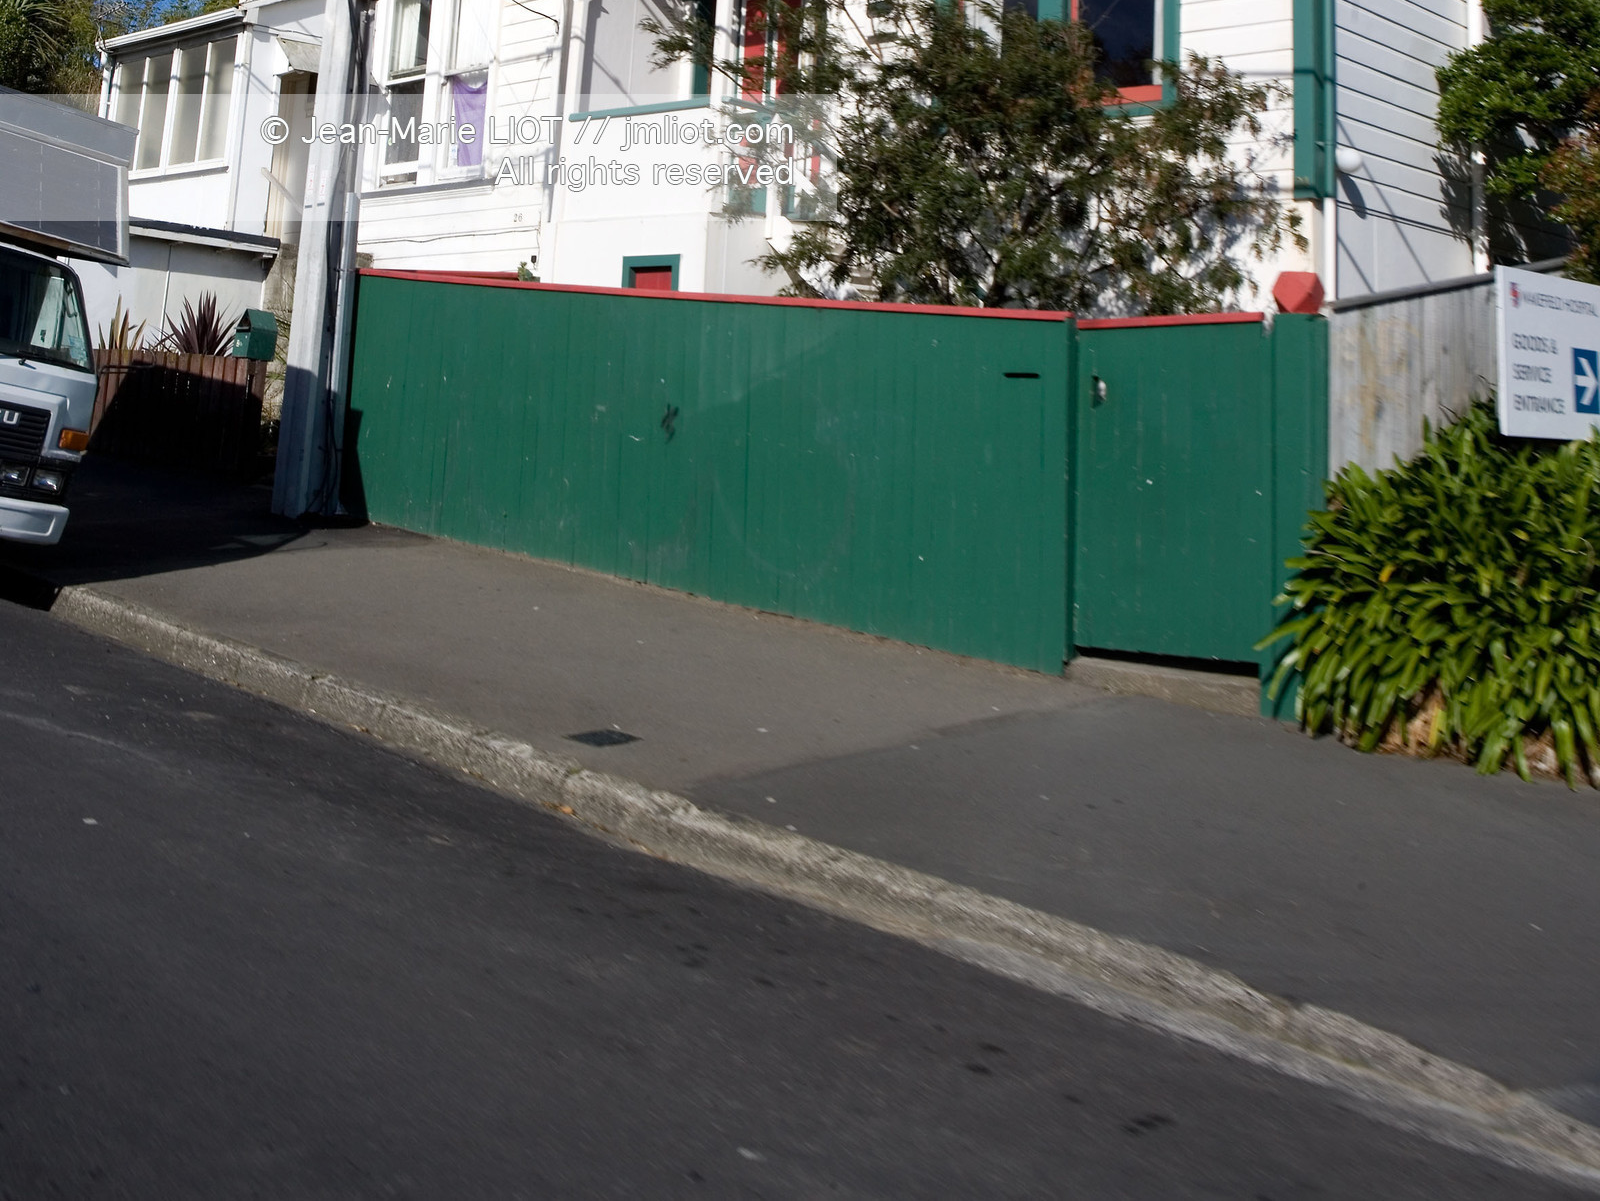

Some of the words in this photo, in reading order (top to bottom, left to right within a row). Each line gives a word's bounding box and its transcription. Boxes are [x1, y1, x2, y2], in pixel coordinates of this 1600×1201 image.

[1512, 333, 1549, 354] GOODS
[1512, 363, 1553, 384] SERVICE
[1513, 394, 1566, 415] ENTRANCE
[0, 409, 19, 425] U
